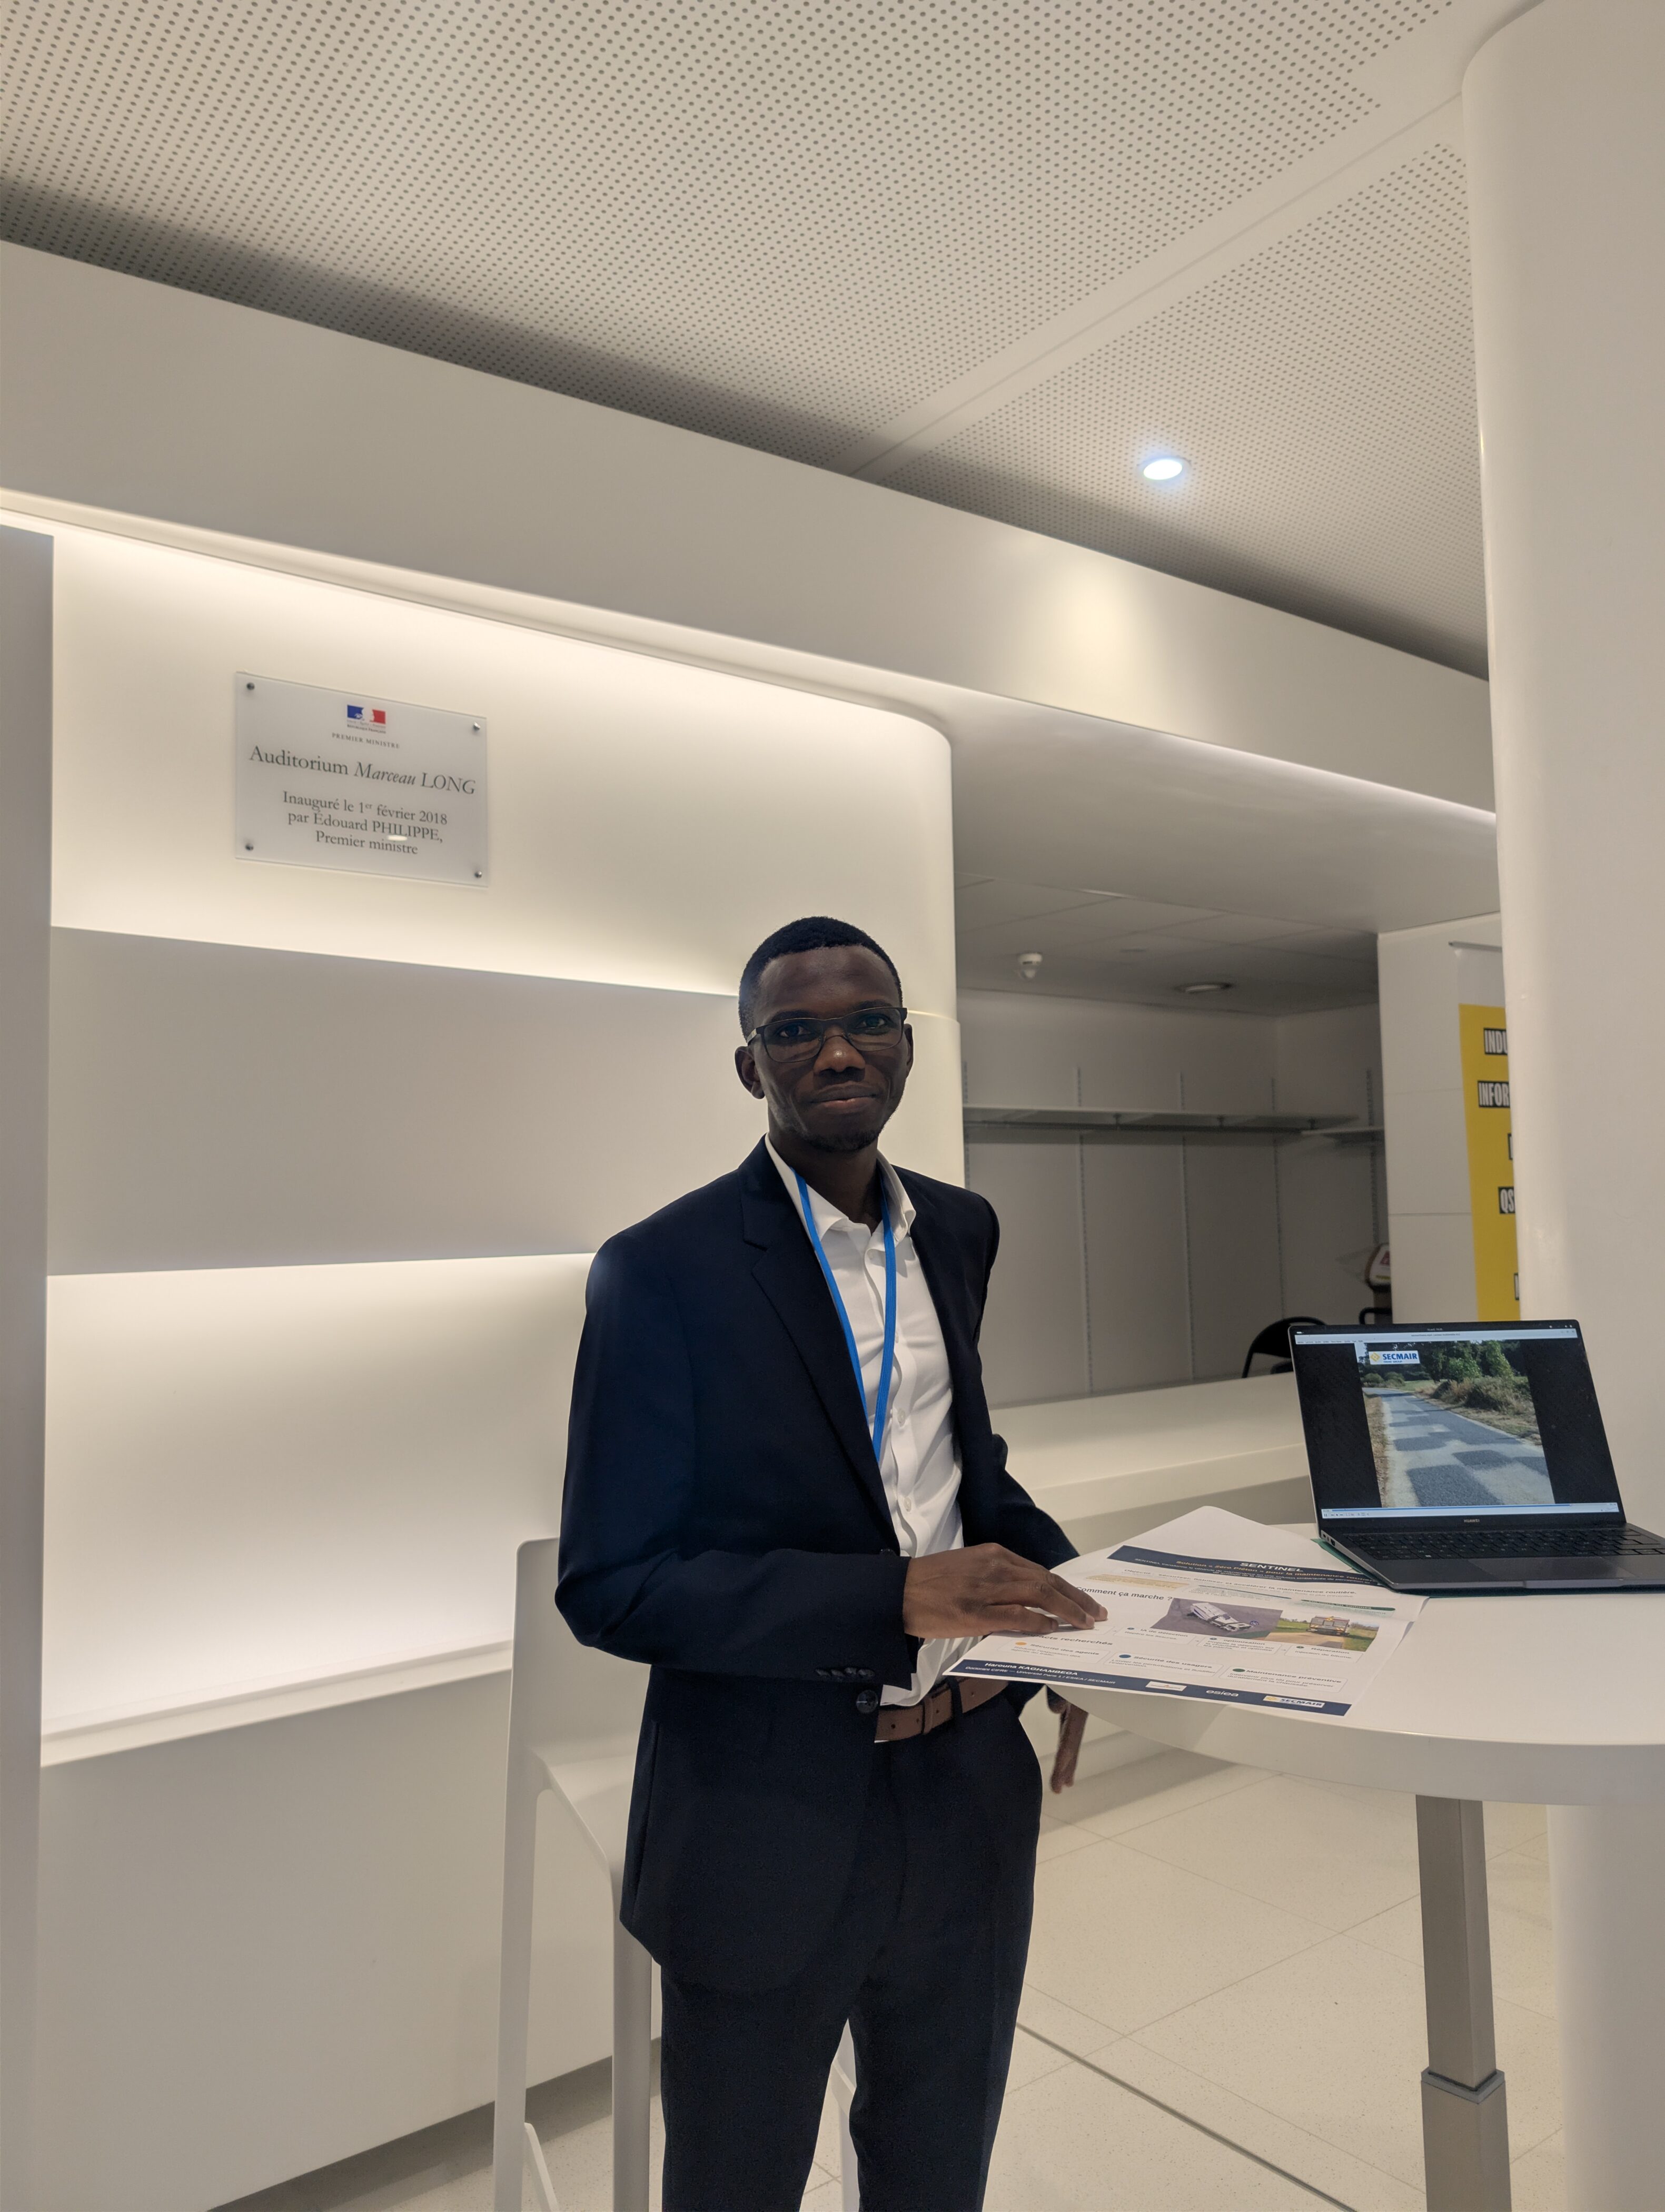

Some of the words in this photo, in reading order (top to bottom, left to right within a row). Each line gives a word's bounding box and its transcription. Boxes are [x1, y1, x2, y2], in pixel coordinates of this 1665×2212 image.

[332, 733, 363, 743] PREMIER
[366, 738, 400, 749] MINISTRE
[249, 745, 349, 775] Auditorium
[354, 761, 417, 785] Marceau
[421, 772, 476, 795] LONG
[283, 791, 340, 811] Inauguré
[344, 799, 354, 812] le
[376, 804, 416, 821] février
[419, 810, 448, 825] 2018
[288, 813, 310, 825] par
[314, 809, 368, 831] Édouard
[372, 820, 443, 843] PHILIPPE,
[316, 829, 365, 848] Premier
[369, 838, 419, 855] ministre
[1240, 1563, 1304, 1573] SENTINEL
[1131, 1592, 1164, 1601] marche
[1061, 1637, 1114, 1645] recherchés
[1018, 1664, 1078, 1676] KAGHAMBEGA
[1246, 1670, 1297, 1678] Maintenance
[1299, 1675, 1342, 1684] préventive
[1281, 1697, 1323, 1707] SECMAIR
